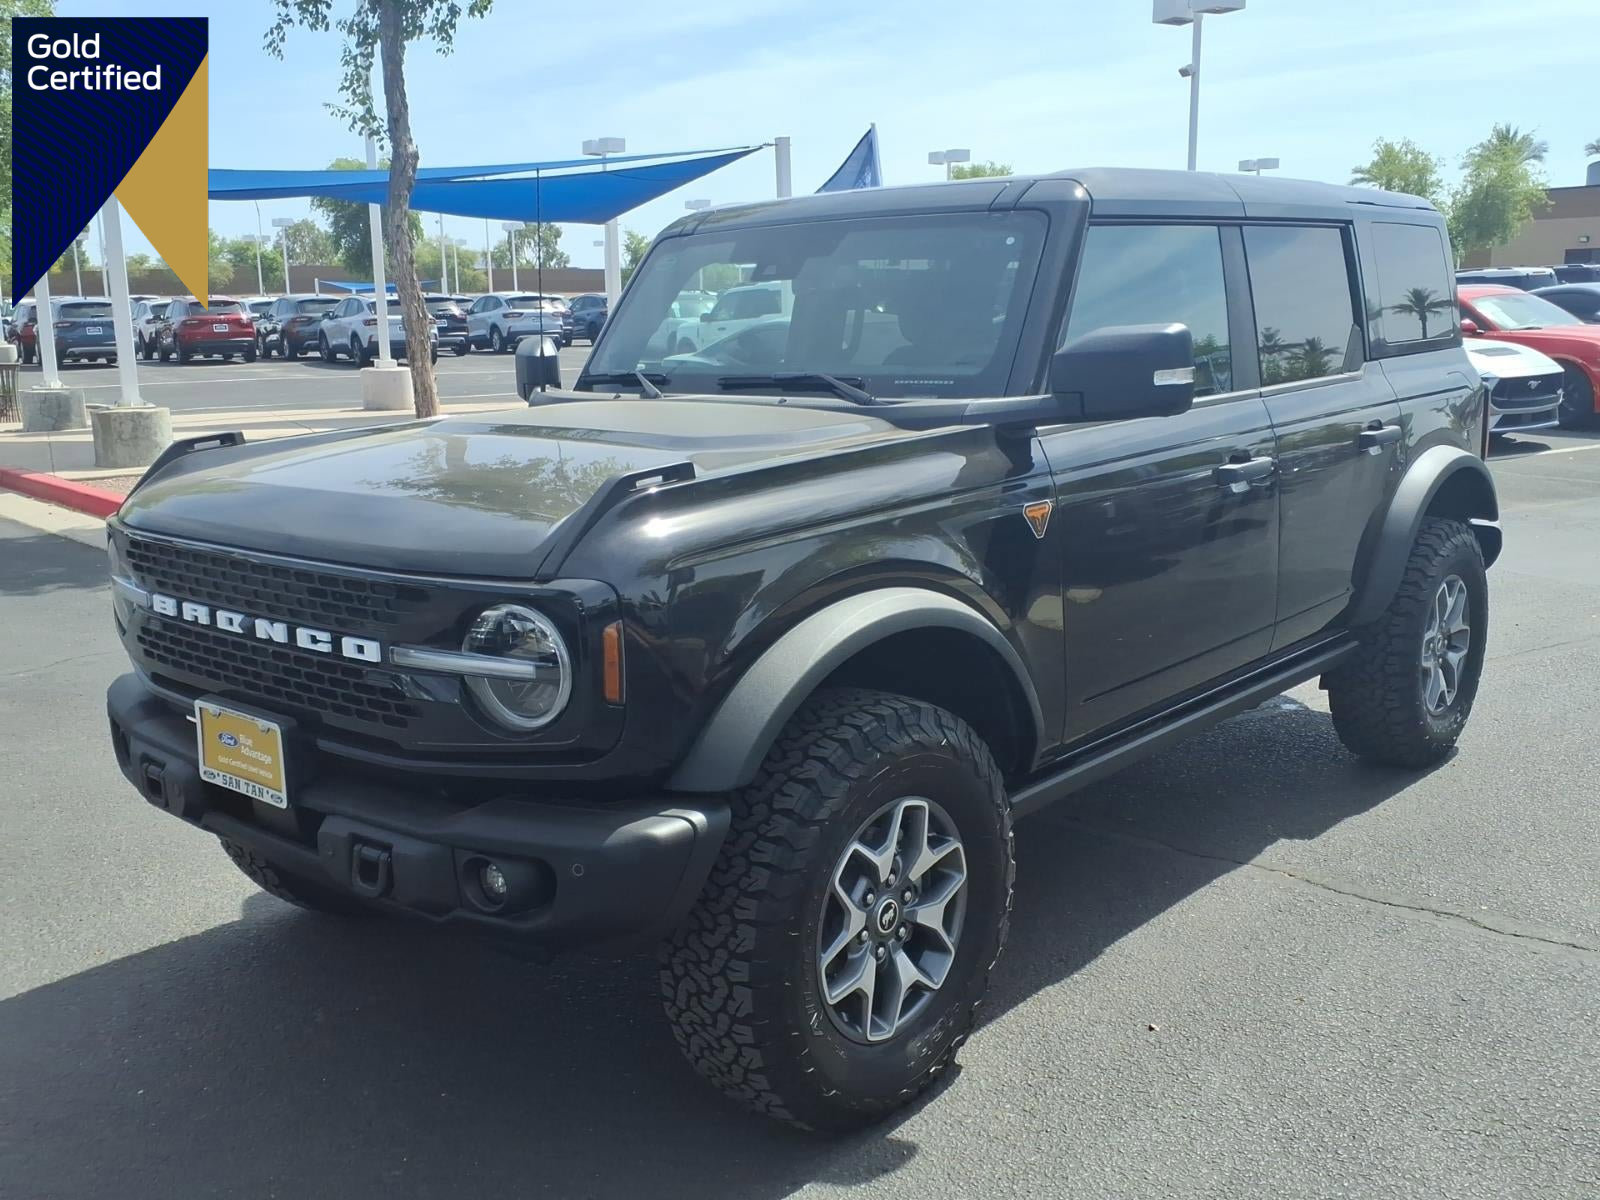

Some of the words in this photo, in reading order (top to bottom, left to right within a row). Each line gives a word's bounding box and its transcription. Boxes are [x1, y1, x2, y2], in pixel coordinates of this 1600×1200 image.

[152, 593, 382, 662] BRONCO
[219, 732, 238, 746] Ford
[222, 774, 241, 790] SAN
[244, 782, 264, 798] TAN
